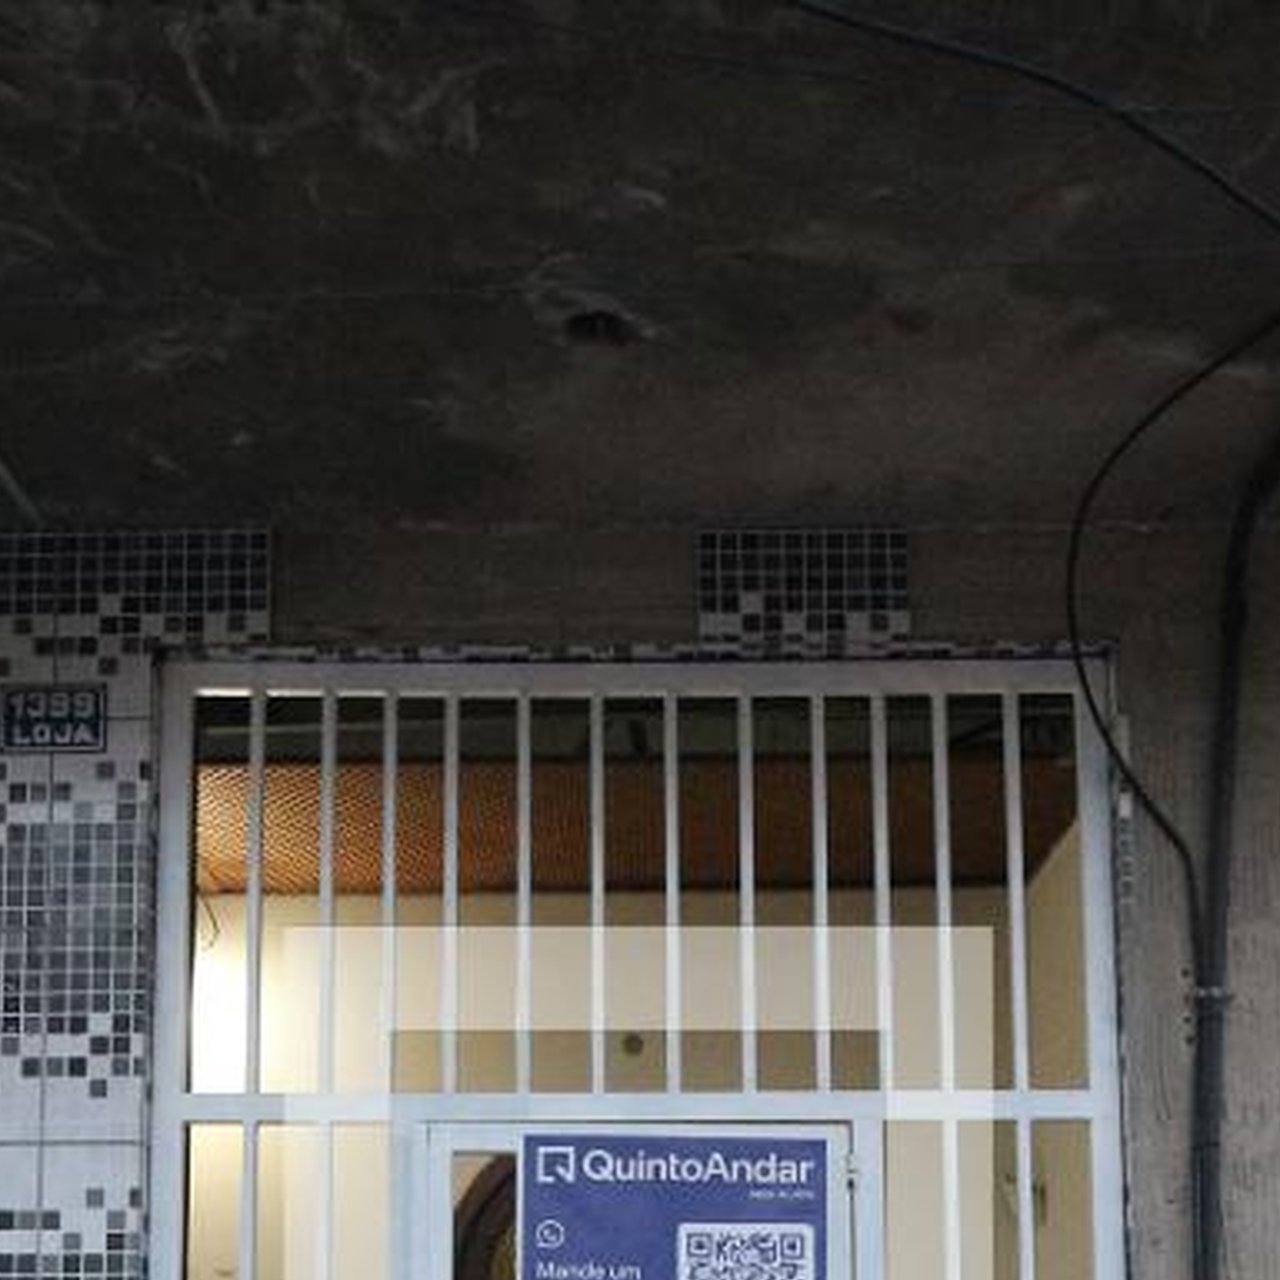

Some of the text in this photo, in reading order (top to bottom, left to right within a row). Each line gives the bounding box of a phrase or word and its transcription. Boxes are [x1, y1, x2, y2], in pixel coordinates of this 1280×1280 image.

[12, 722, 97, 744] LOJA
[582, 1148, 816, 1184] QuintoAndar
[536, 1262, 641, 1280] Mande um
